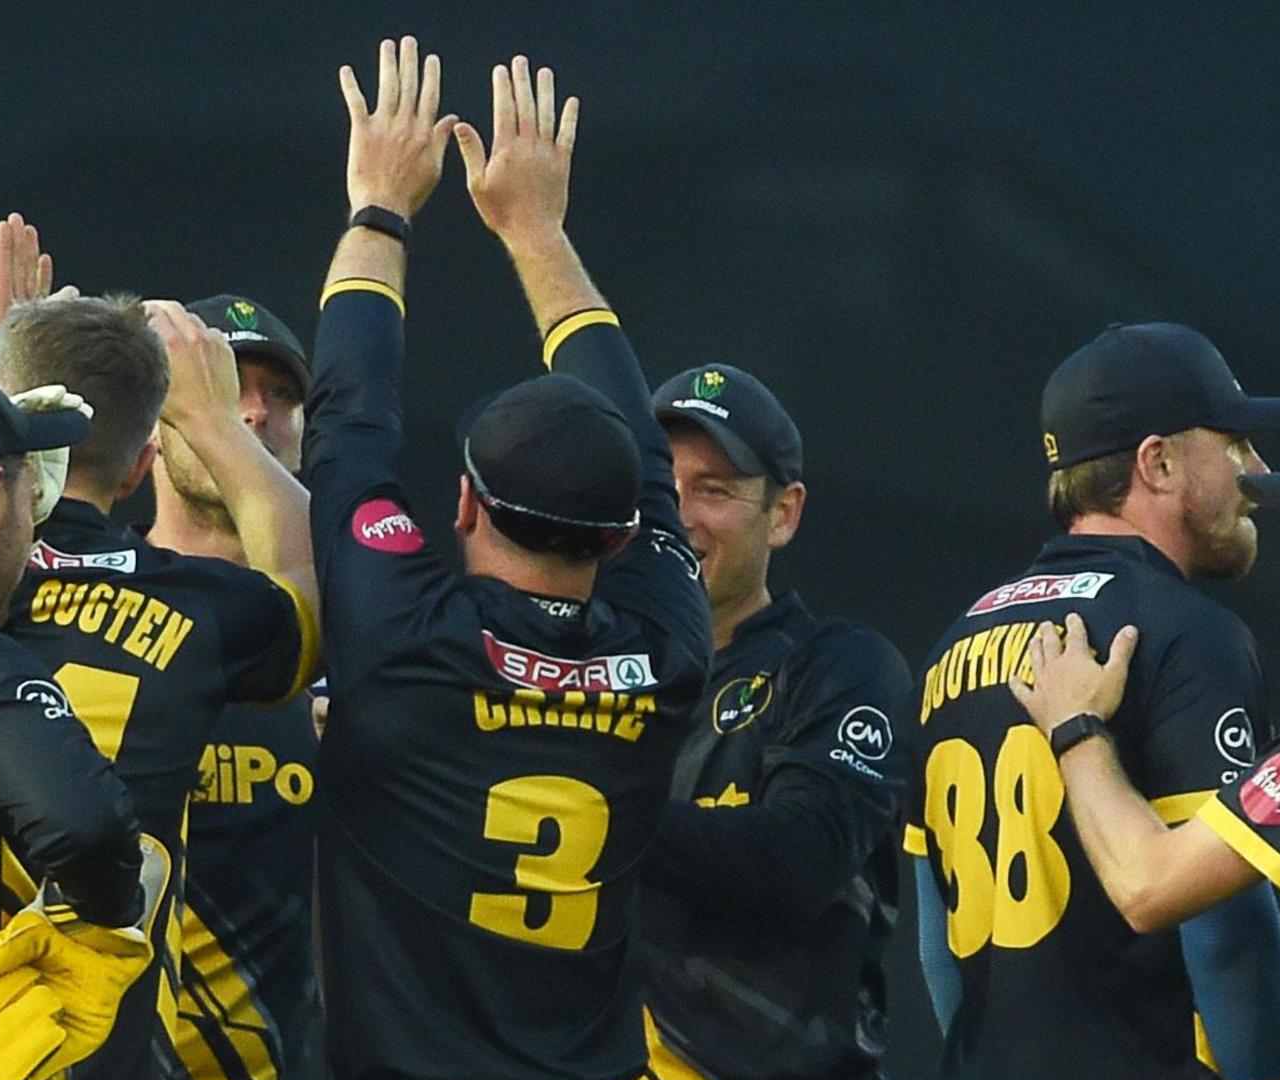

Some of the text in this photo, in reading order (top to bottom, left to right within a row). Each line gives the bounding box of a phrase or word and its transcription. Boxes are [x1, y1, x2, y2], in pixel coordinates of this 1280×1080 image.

[993, 577, 1066, 606] SPAR
[503, 652, 609, 687] SPAR
[474, 688, 657, 742] CRANE
[846, 721, 882, 749] CM
[469, 775, 610, 950] 3
[924, 723, 1071, 959] 88
